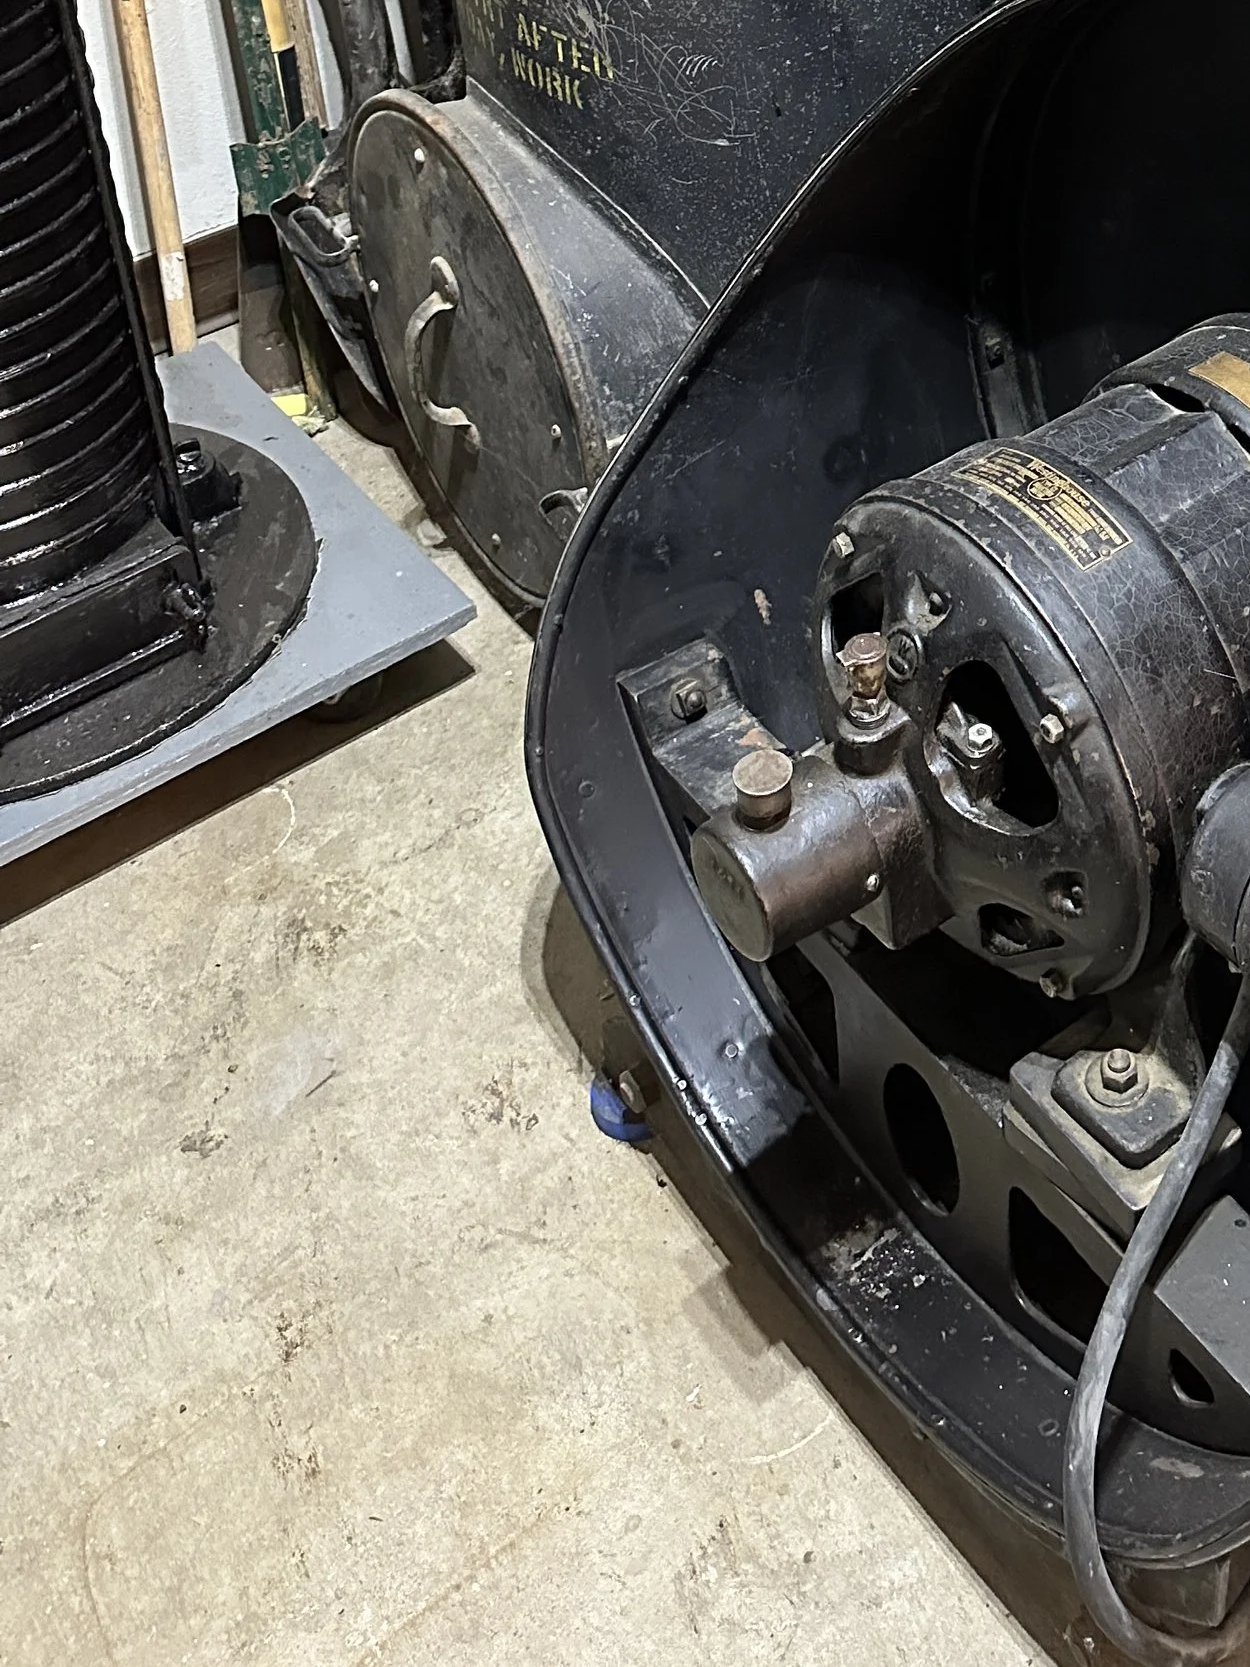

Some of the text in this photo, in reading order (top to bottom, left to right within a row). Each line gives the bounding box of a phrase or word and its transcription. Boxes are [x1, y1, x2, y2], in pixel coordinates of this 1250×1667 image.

[511, 46, 584, 111] WORK
[516, 12, 614, 80] AFTER
[1026, 459, 1092, 508] Westinghouse
